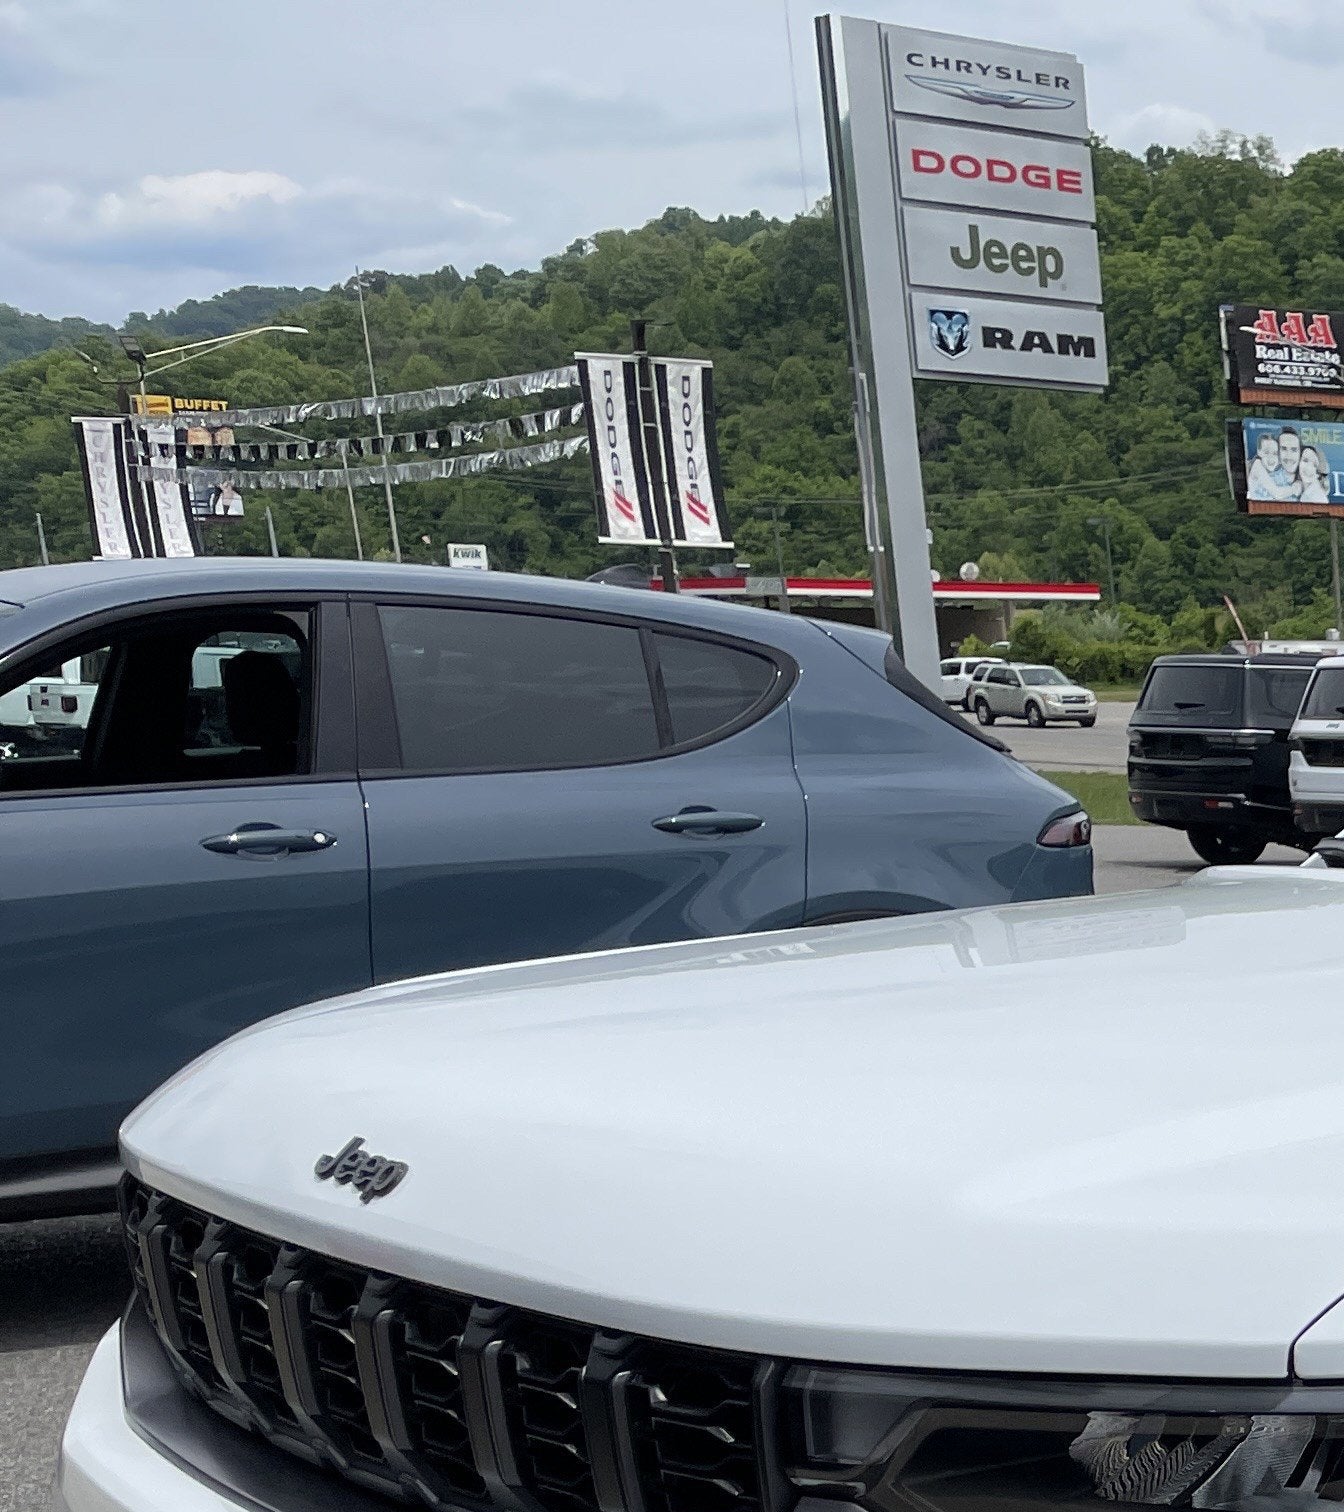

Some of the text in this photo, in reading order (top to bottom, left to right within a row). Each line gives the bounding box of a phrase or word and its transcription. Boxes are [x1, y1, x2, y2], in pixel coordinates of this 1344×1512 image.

[906, 52, 1072, 91] CHRYSLER
[911, 148, 1083, 194] DODGE
[949, 224, 1064, 288] Jeep
[981, 325, 1096, 359] RAM
[1255, 345, 1289, 360] Real
[174, 398, 229, 412] BUFFET
[604, 370, 626, 499] DODGE
[681, 375, 701, 501] DODGE
[313, 1136, 409, 1206] Jeep
